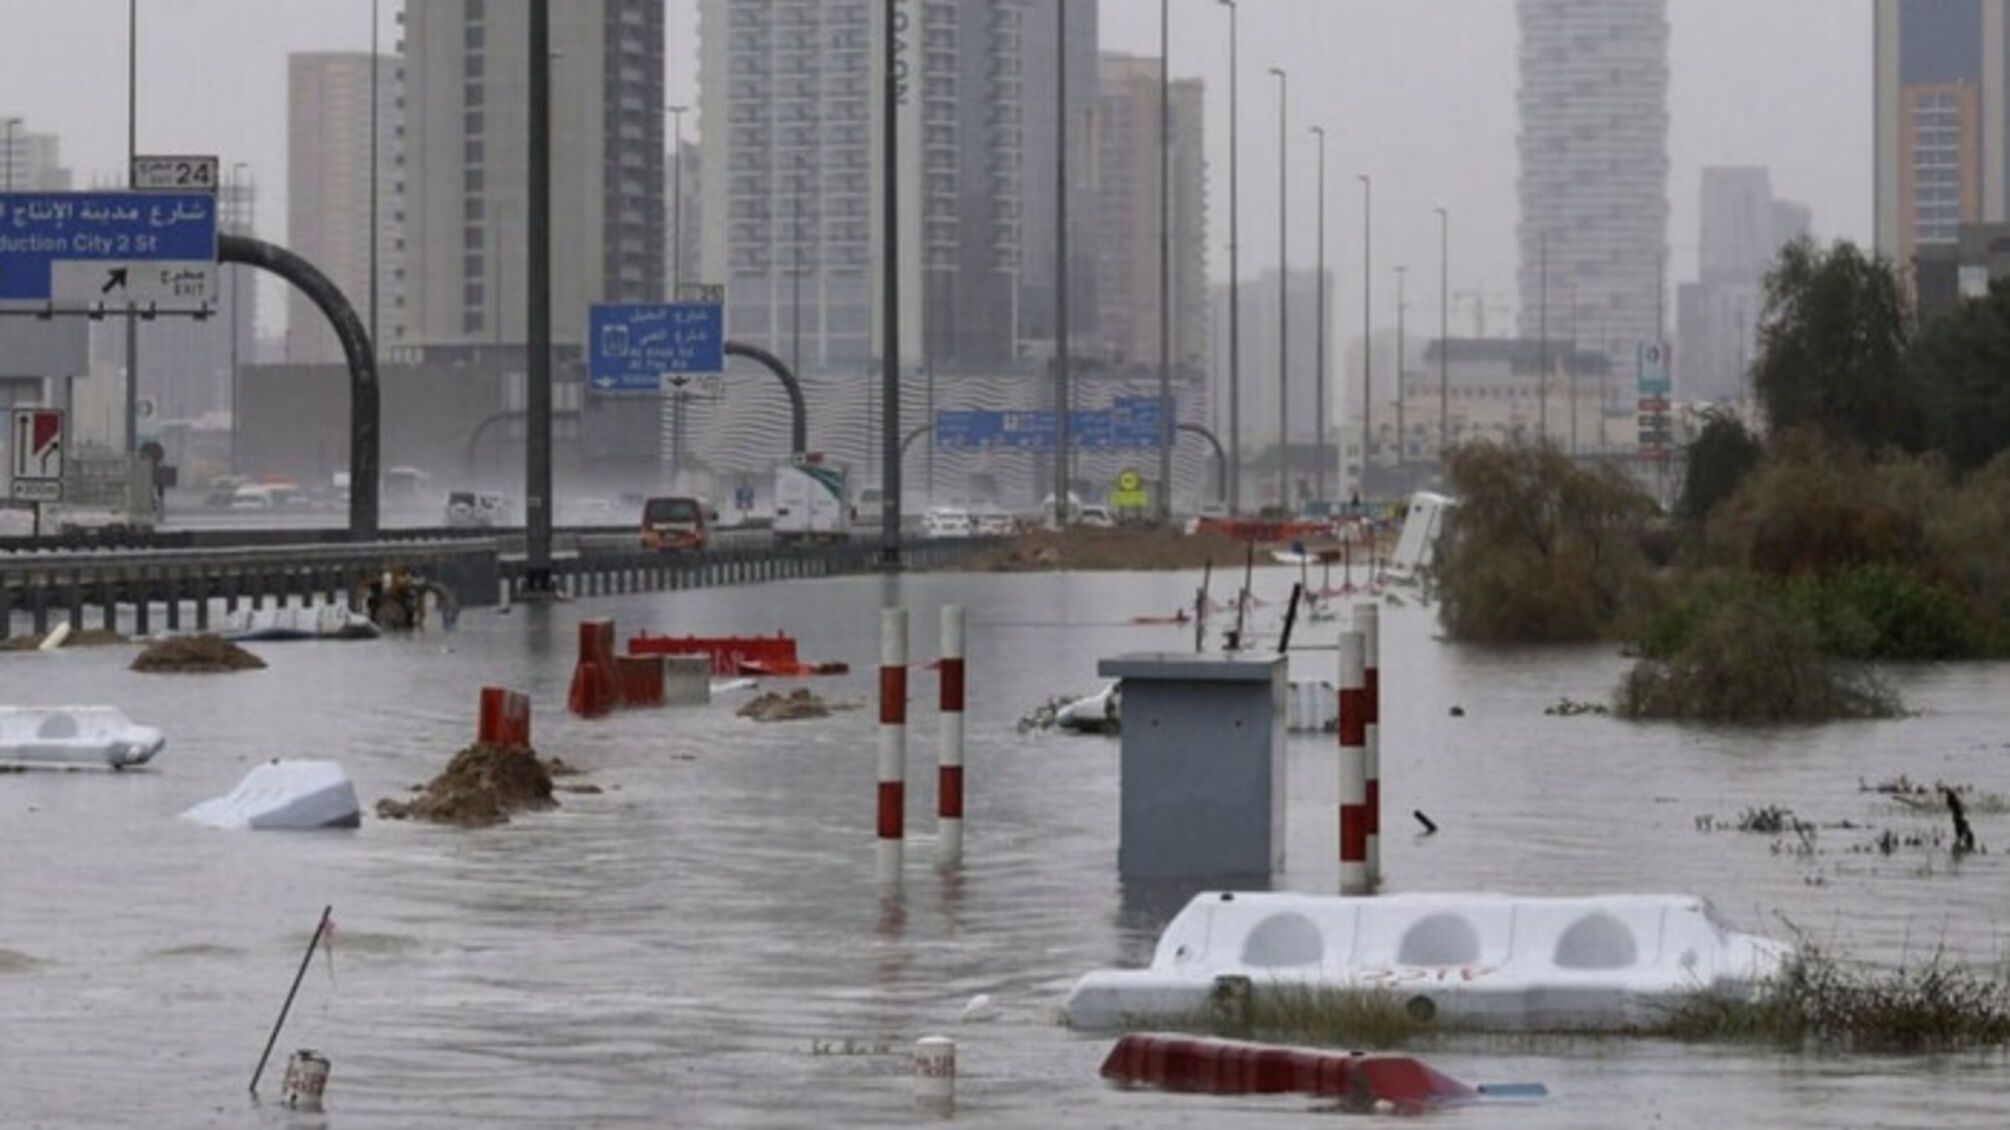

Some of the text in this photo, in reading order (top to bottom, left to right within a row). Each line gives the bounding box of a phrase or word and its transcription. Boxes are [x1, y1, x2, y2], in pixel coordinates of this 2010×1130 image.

[176, 161, 209, 185] 24
[80, 202, 139, 224] مدينة
[151, 202, 206, 227] شارع
[72, 234, 112, 254] City
[116, 235, 130, 252] 2
[134, 235, 157, 252] St
[174, 284, 205, 297] EXIT
